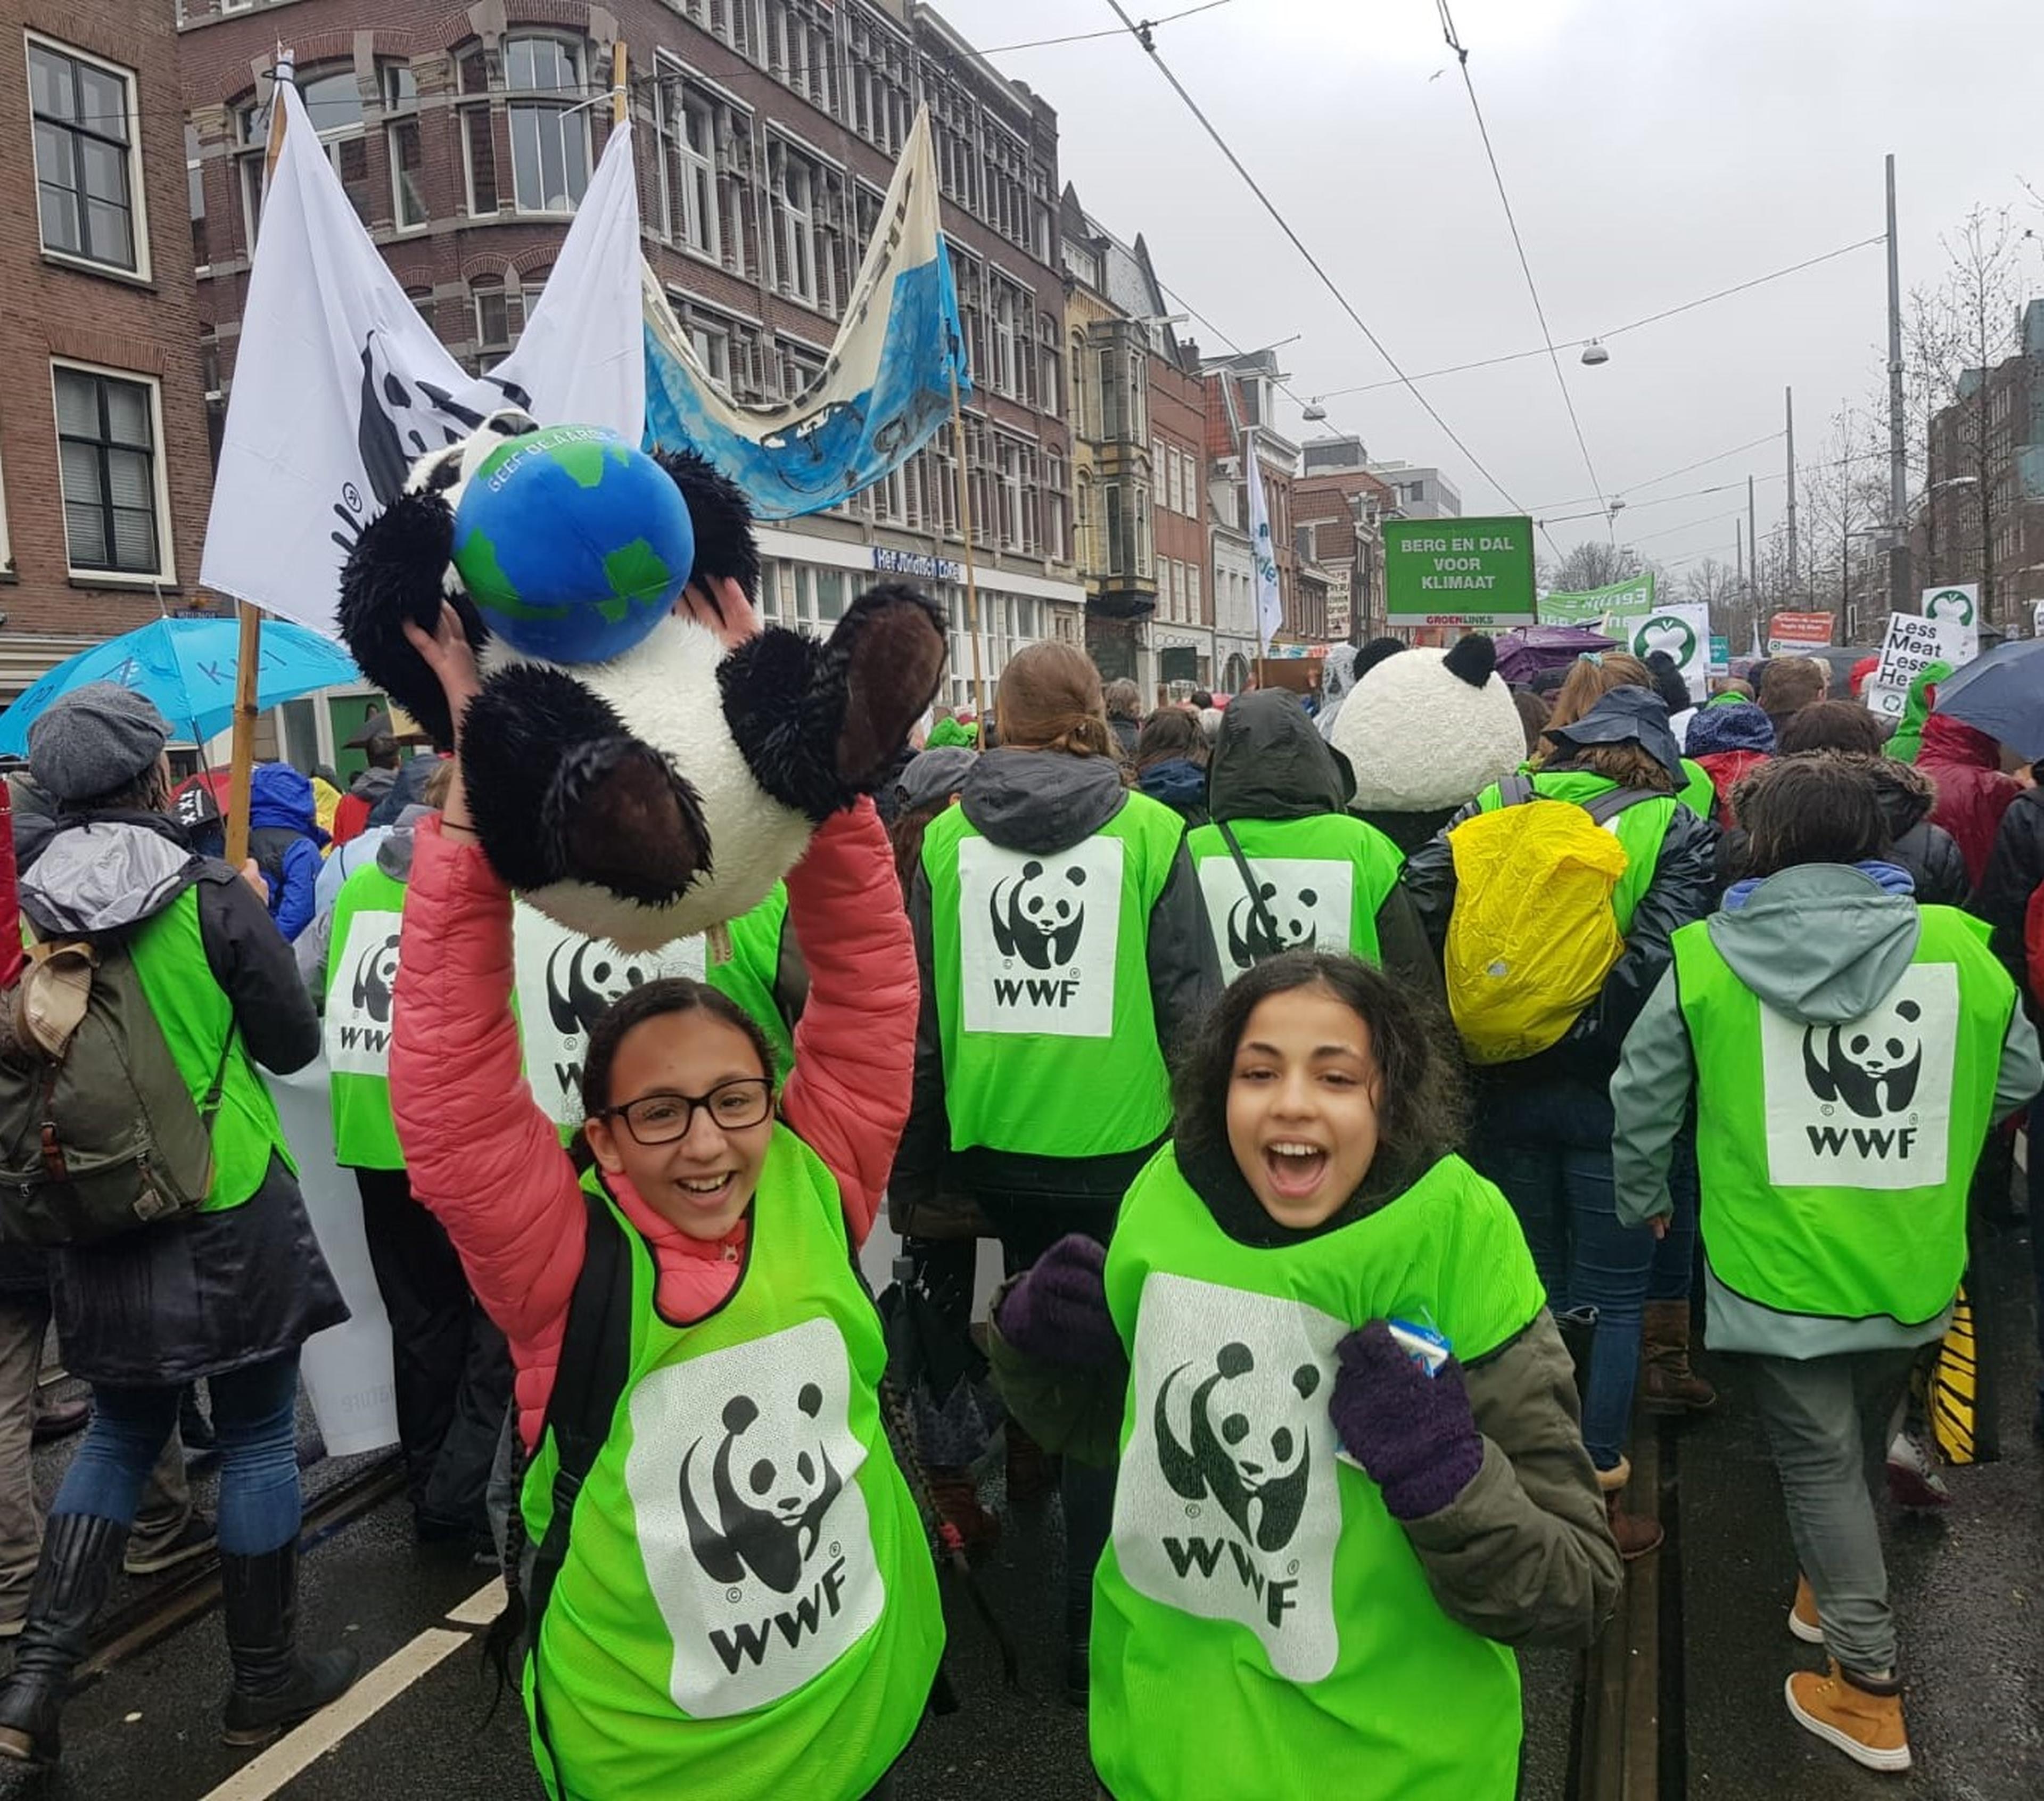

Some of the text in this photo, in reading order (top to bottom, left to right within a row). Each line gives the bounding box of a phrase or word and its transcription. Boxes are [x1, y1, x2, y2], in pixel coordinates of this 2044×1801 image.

[488, 451, 523, 492] GEEF
[1401, 537, 1514, 552] BERG EN DAL
[1433, 558, 1481, 571] VOOR
[1422, 576, 1495, 589] KLIMAAT
[1427, 616, 1494, 625] GROENLINKS
[1893, 616, 1936, 638] Less
[1889, 633, 1942, 658] Meat
[1879, 667, 1915, 687] He
[993, 979, 1080, 1008] WWF
[341, 1026, 392, 1053] WW
[1806, 1125, 1917, 1159] WWF
[1163, 1537, 1298, 1629] WWF
[709, 1556, 845, 1674] WWF
